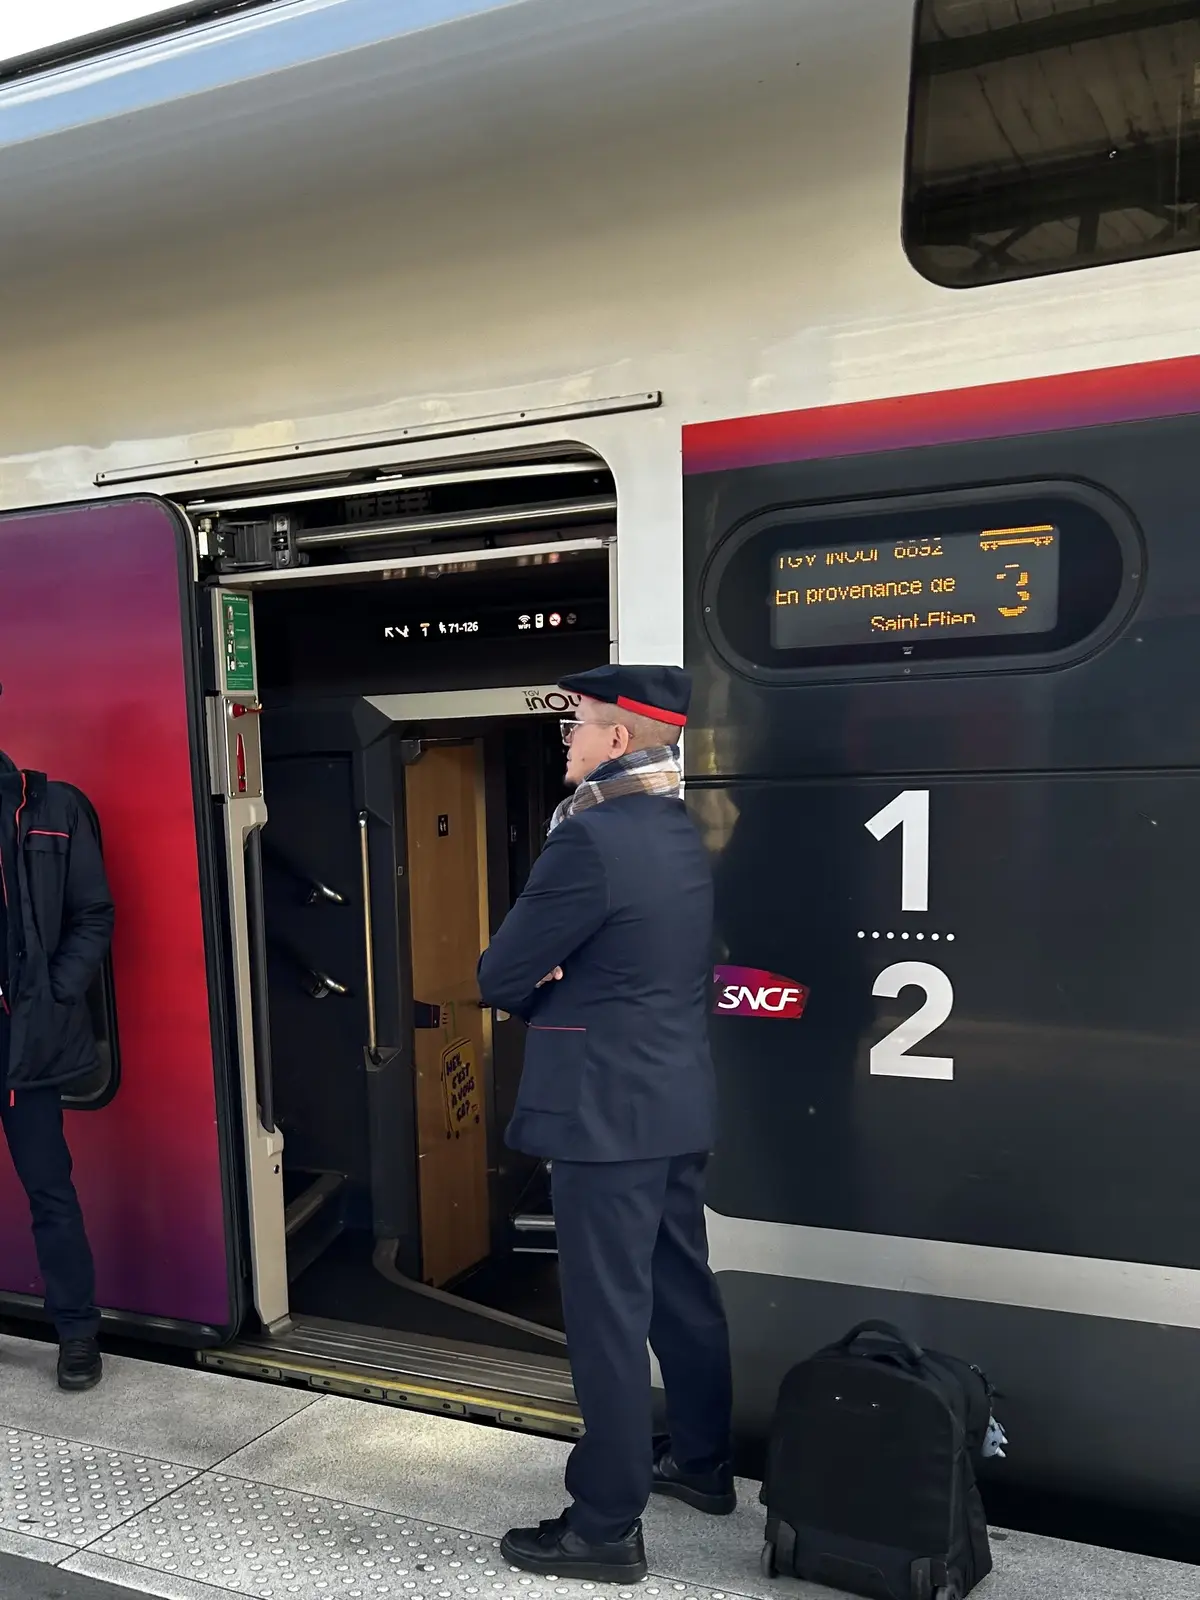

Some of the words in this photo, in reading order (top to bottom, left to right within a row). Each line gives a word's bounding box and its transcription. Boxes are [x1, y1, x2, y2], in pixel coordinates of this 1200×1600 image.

[775, 588, 799, 605] En
[806, 580, 923, 604] provenance
[930, 576, 956, 594] de
[448, 621, 479, 634] 71-126
[522, 689, 540, 697] TGV
[525, 692, 582, 711] inOu
[864, 789, 930, 912] 1
[717, 984, 801, 1011] SNCF
[869, 961, 954, 1081] 2
